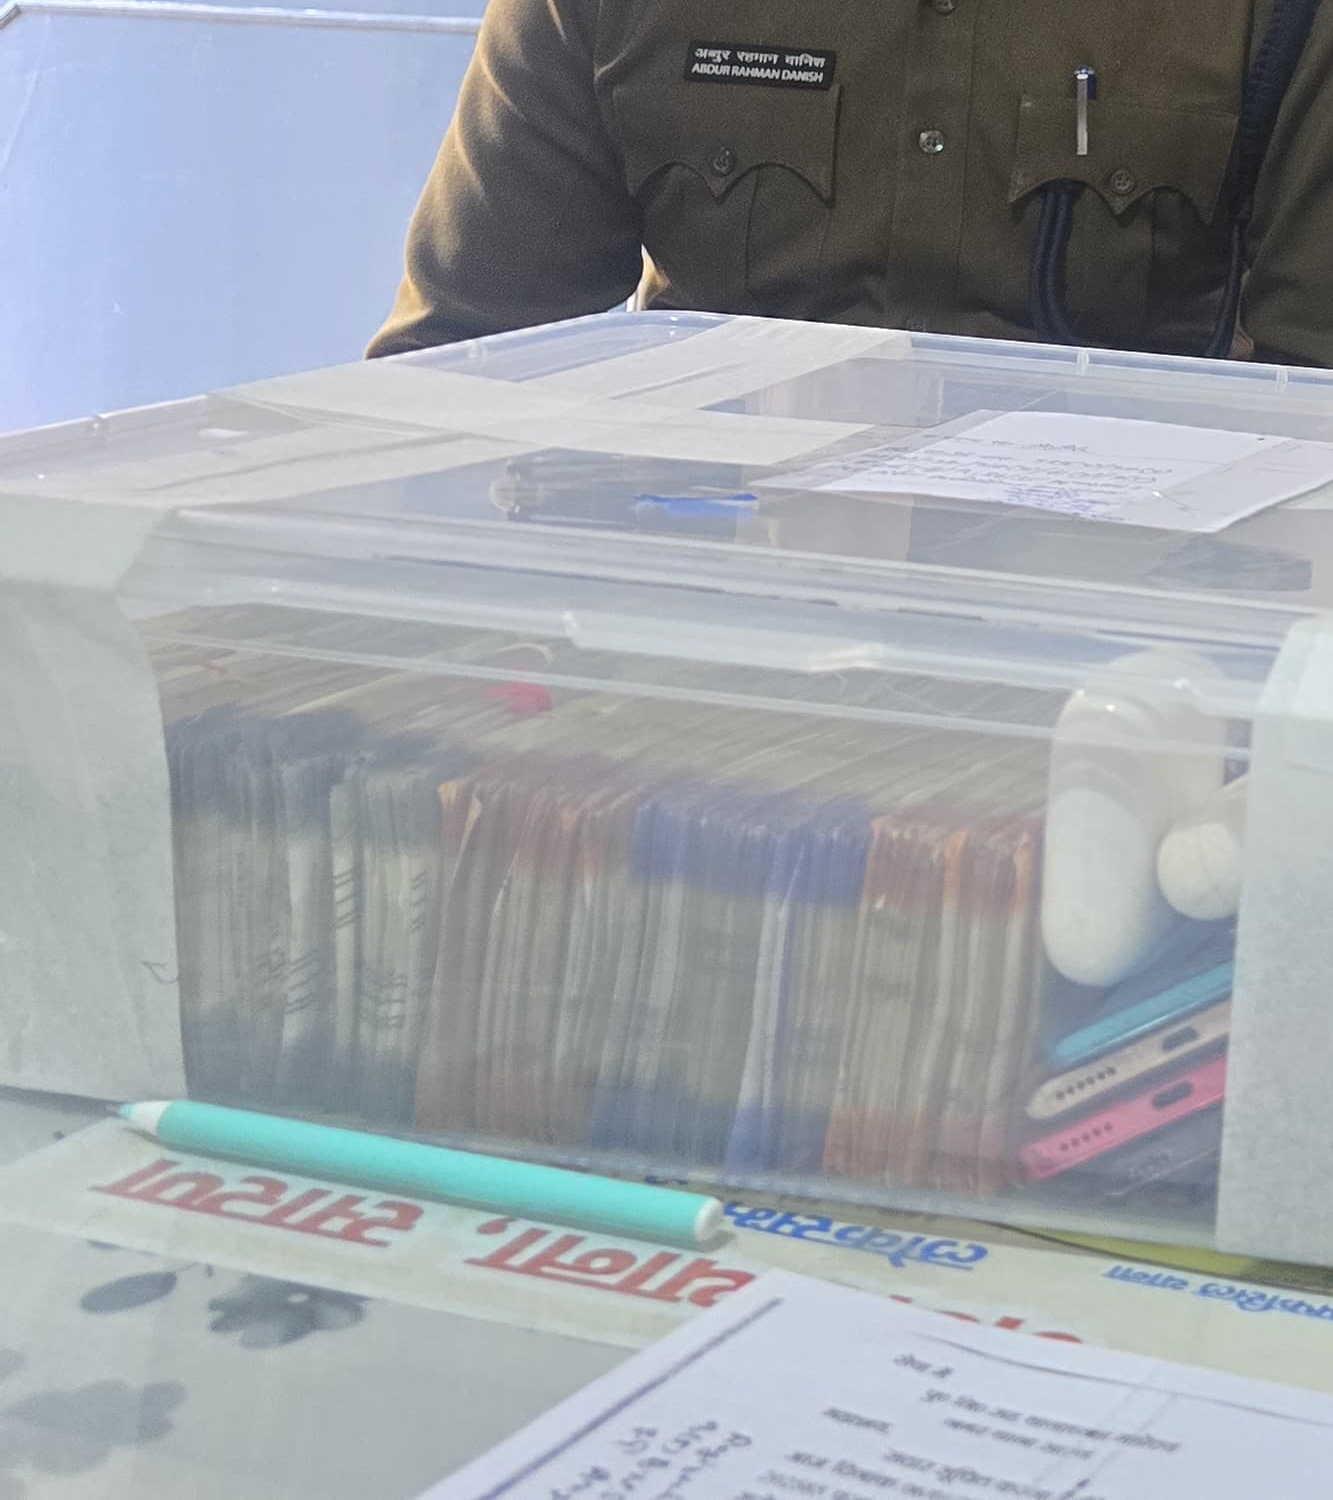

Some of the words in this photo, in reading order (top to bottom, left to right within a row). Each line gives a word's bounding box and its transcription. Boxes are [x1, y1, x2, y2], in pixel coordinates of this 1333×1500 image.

[691, 62, 731, 77] ABDUR
[730, 65, 781, 80] RAHMAN
[781, 69, 824, 84] DANISH
[86, 1158, 425, 1248] सारण
